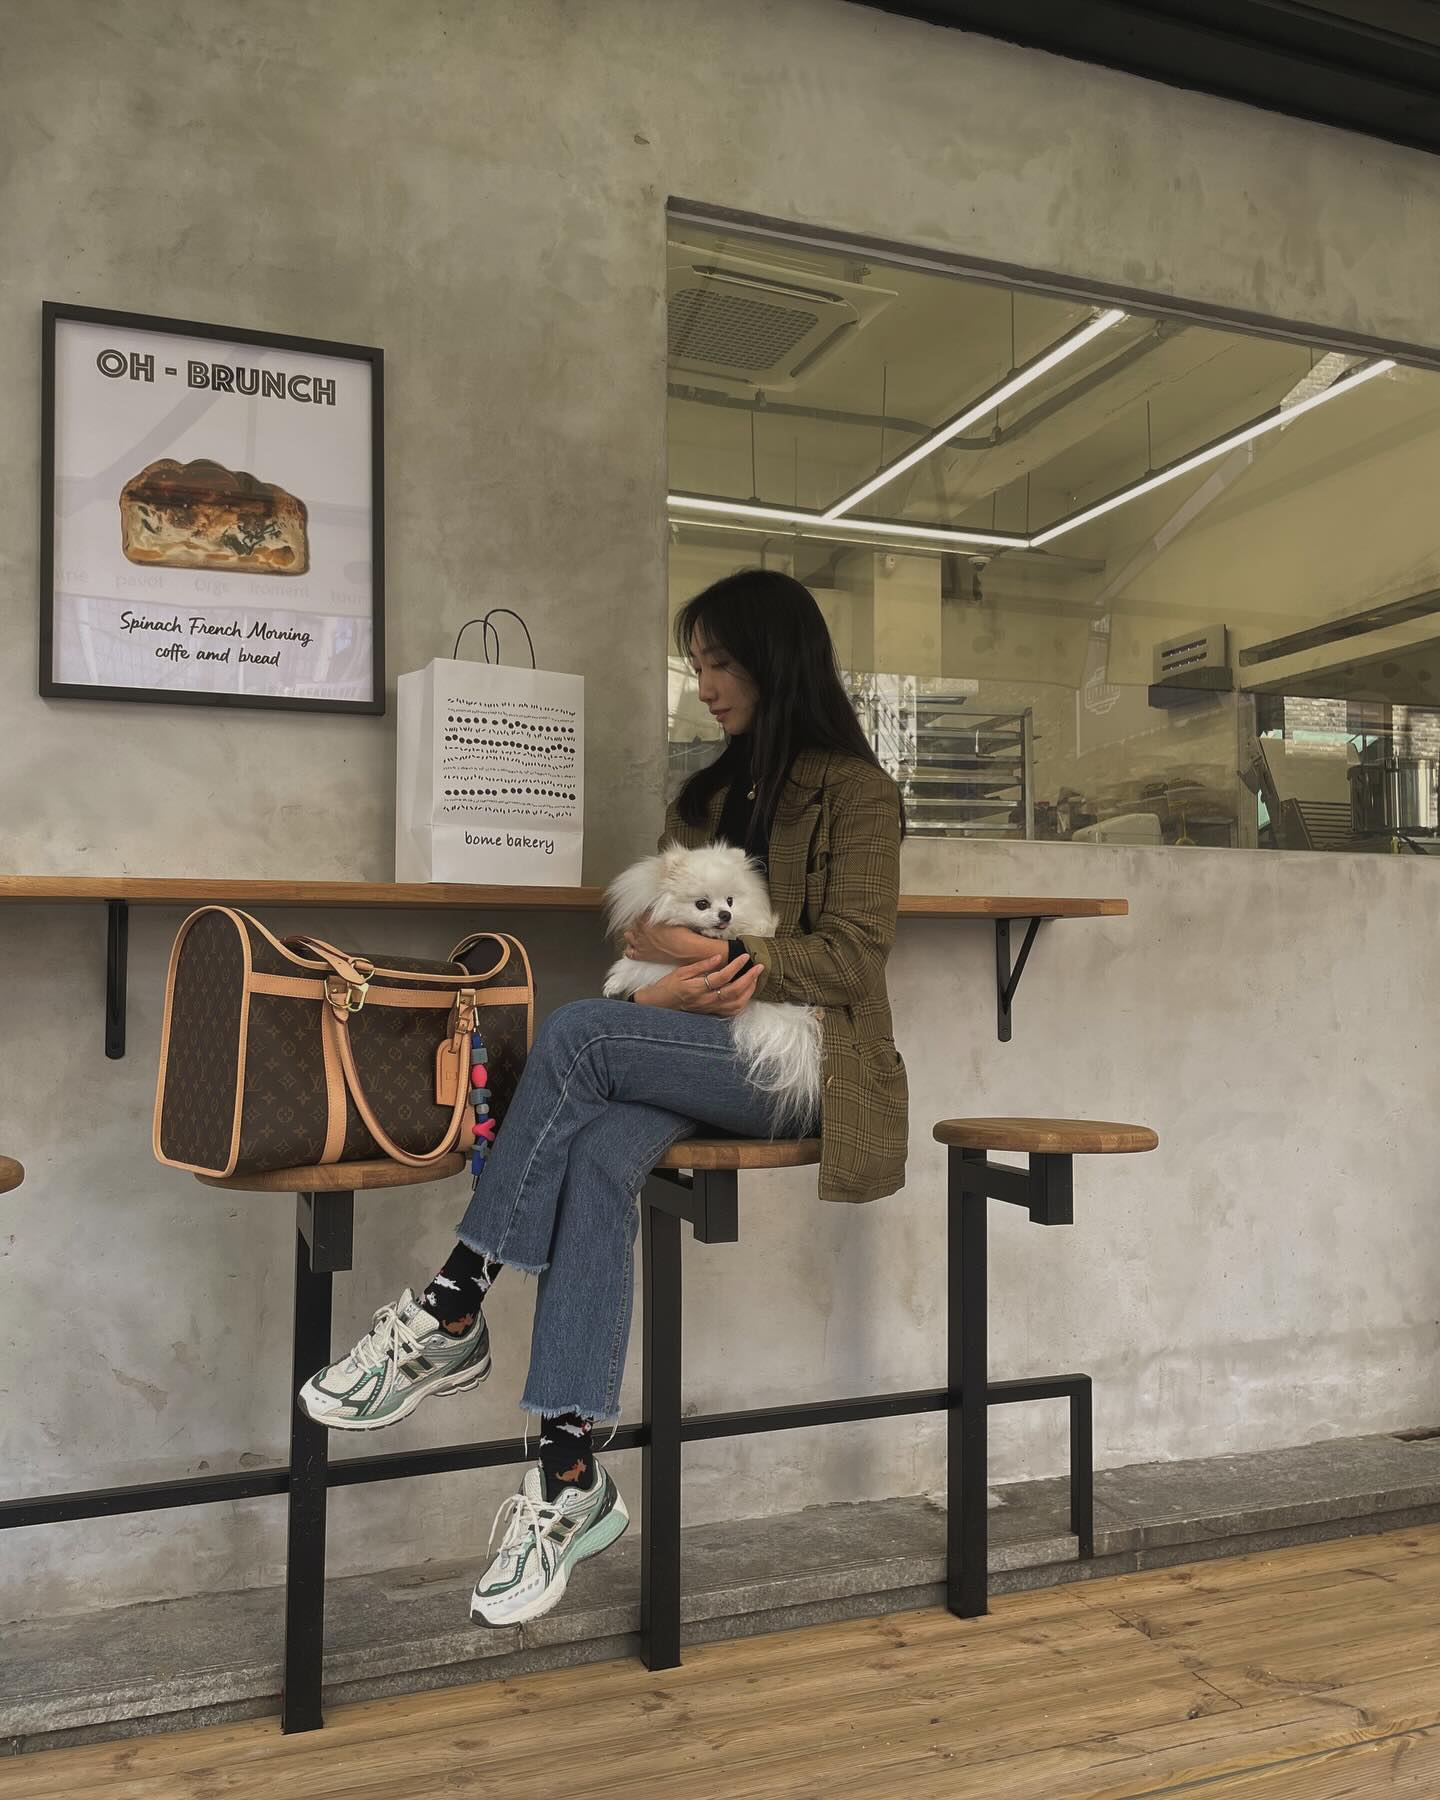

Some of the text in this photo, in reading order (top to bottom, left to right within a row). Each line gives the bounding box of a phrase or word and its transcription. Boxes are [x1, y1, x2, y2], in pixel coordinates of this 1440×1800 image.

[96, 349, 155, 383] OH
[187, 359, 337, 406] BRUNCH
[120, 611, 314, 648] Spinach French Morning
[155, 643, 190, 662] coffe
[238, 648, 281, 667] bread
[465, 831, 554, 855] bome bakery
